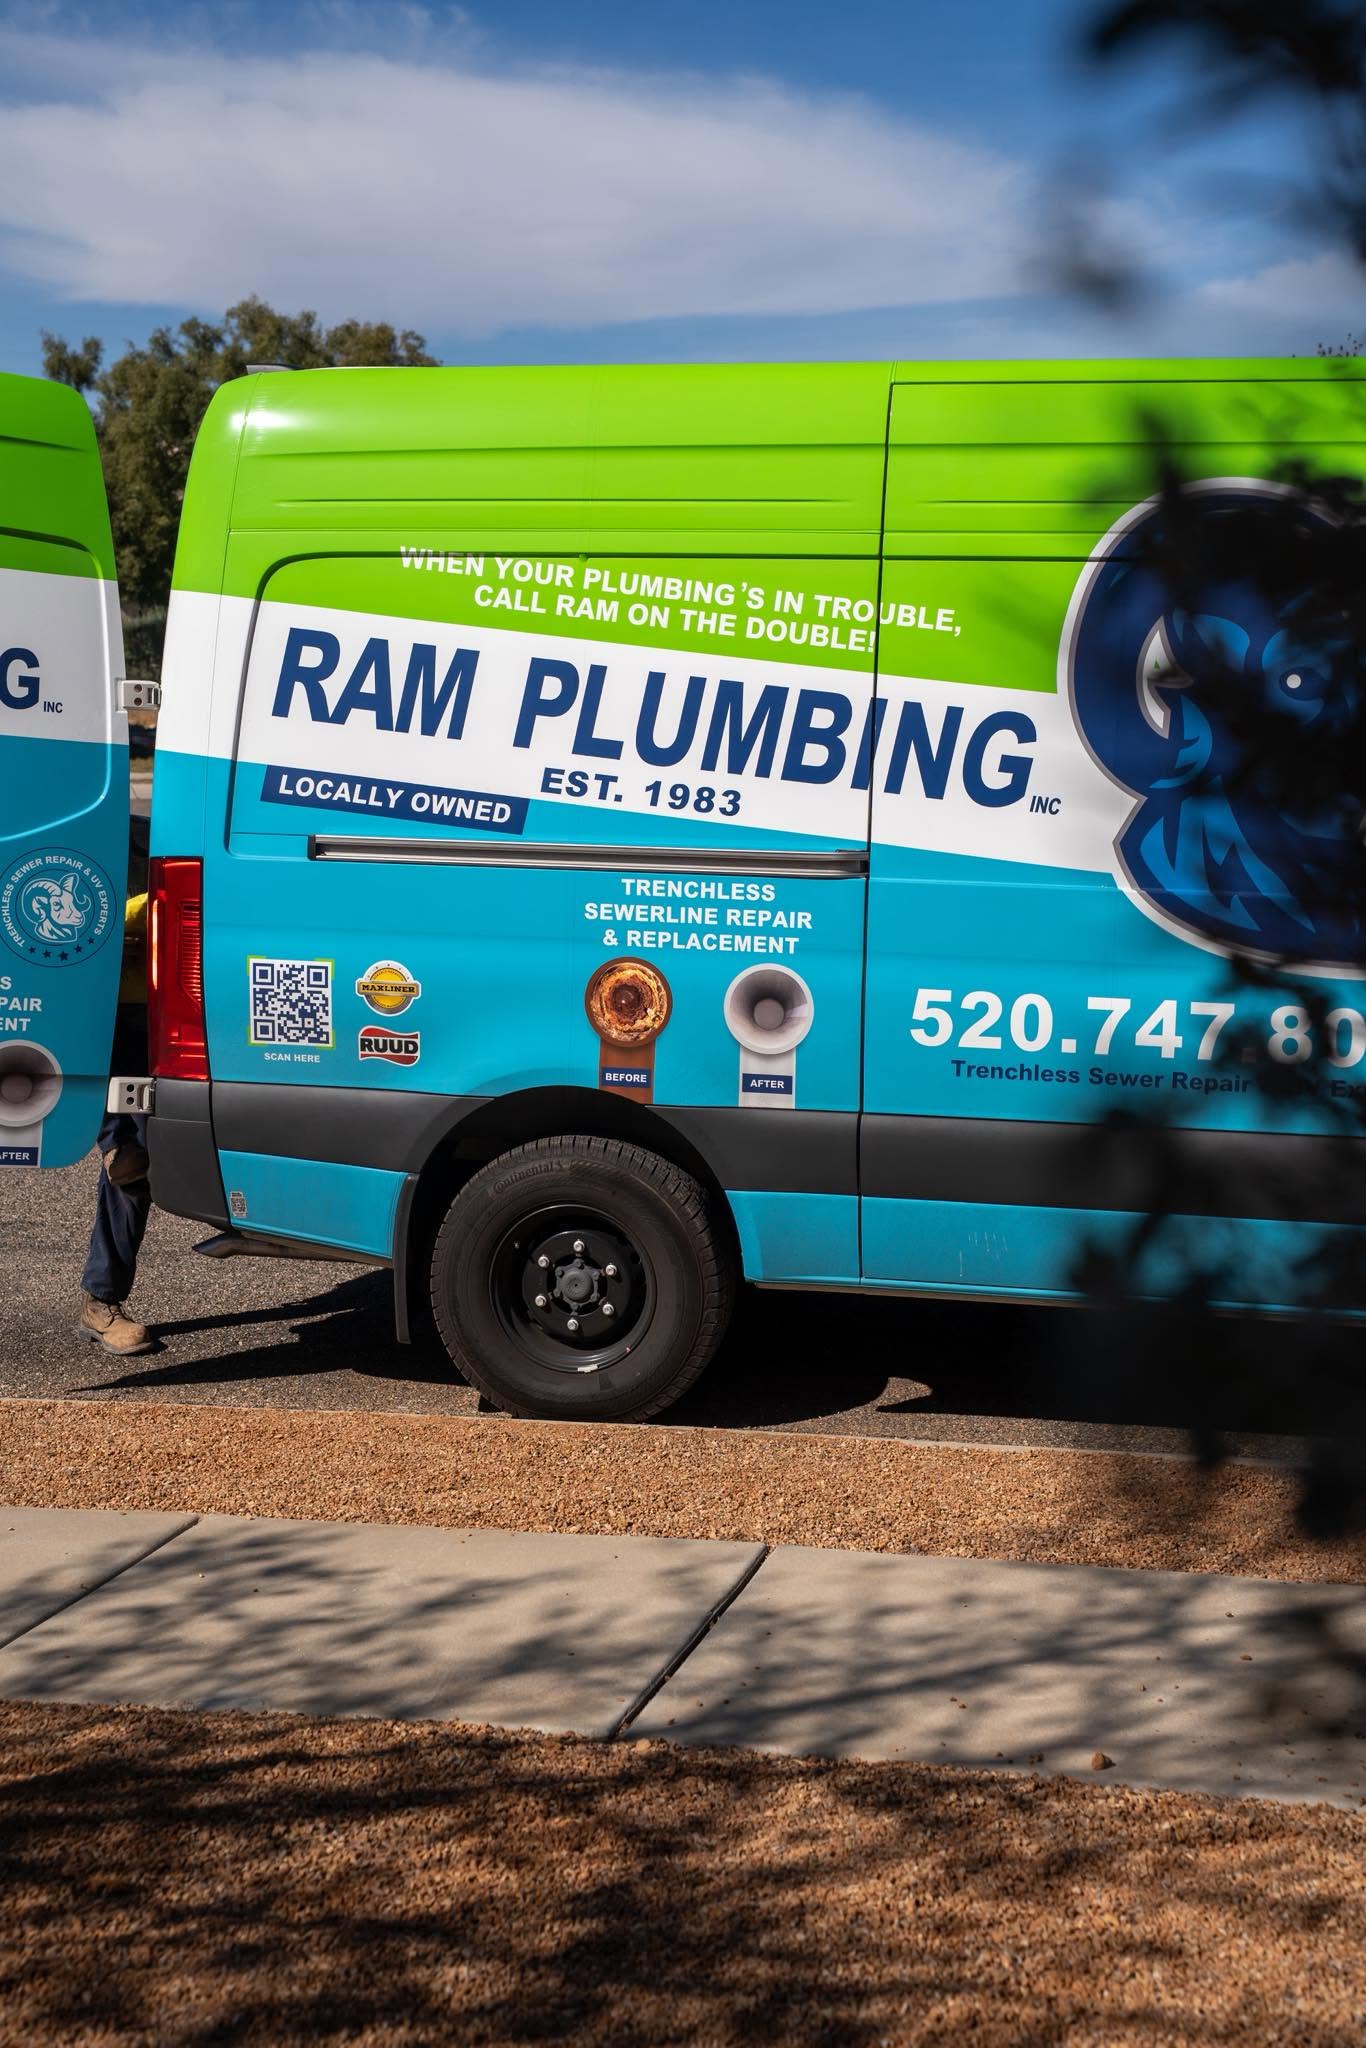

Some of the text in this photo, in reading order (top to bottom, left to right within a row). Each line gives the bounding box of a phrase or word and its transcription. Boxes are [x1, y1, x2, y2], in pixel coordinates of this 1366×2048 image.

[400, 546, 484, 576] WHEN
[494, 557, 573, 587] YOUR
[774, 590, 804, 615] IN
[813, 594, 961, 637] TROUBLE,
[474, 585, 876, 653] CALL RAM ON THE DOUBLE!
[43, 701, 63, 714] INC
[271, 626, 1062, 815] RAM PLUMBING INC
[278, 773, 511, 824] LOCALLY OWNED
[540, 766, 741, 816] EST. 1983
[1, 855, 109, 948] TRENCHLESS SEWER REPAIR & UV EXPERTS
[621, 878, 776, 902] TRENCHLESS
[584, 902, 813, 929] SEWERLINE REPAIR
[602, 929, 800, 955] & REPLACEMENT
[361, 984, 416, 993] MAXLINER
[264, 1052, 321, 1063] SCAN HERE
[360, 1038, 419, 1055] RUUD
[605, 1072, 647, 1083] BEFORE
[750, 1079, 785, 1089] AFTER
[951, 1059, 1080, 1084] Trenchless
[1089, 1067, 1164, 1089] Sewer
[1171, 1071, 1251, 1096] Repair
[0, 1151, 30, 1161] FTER
